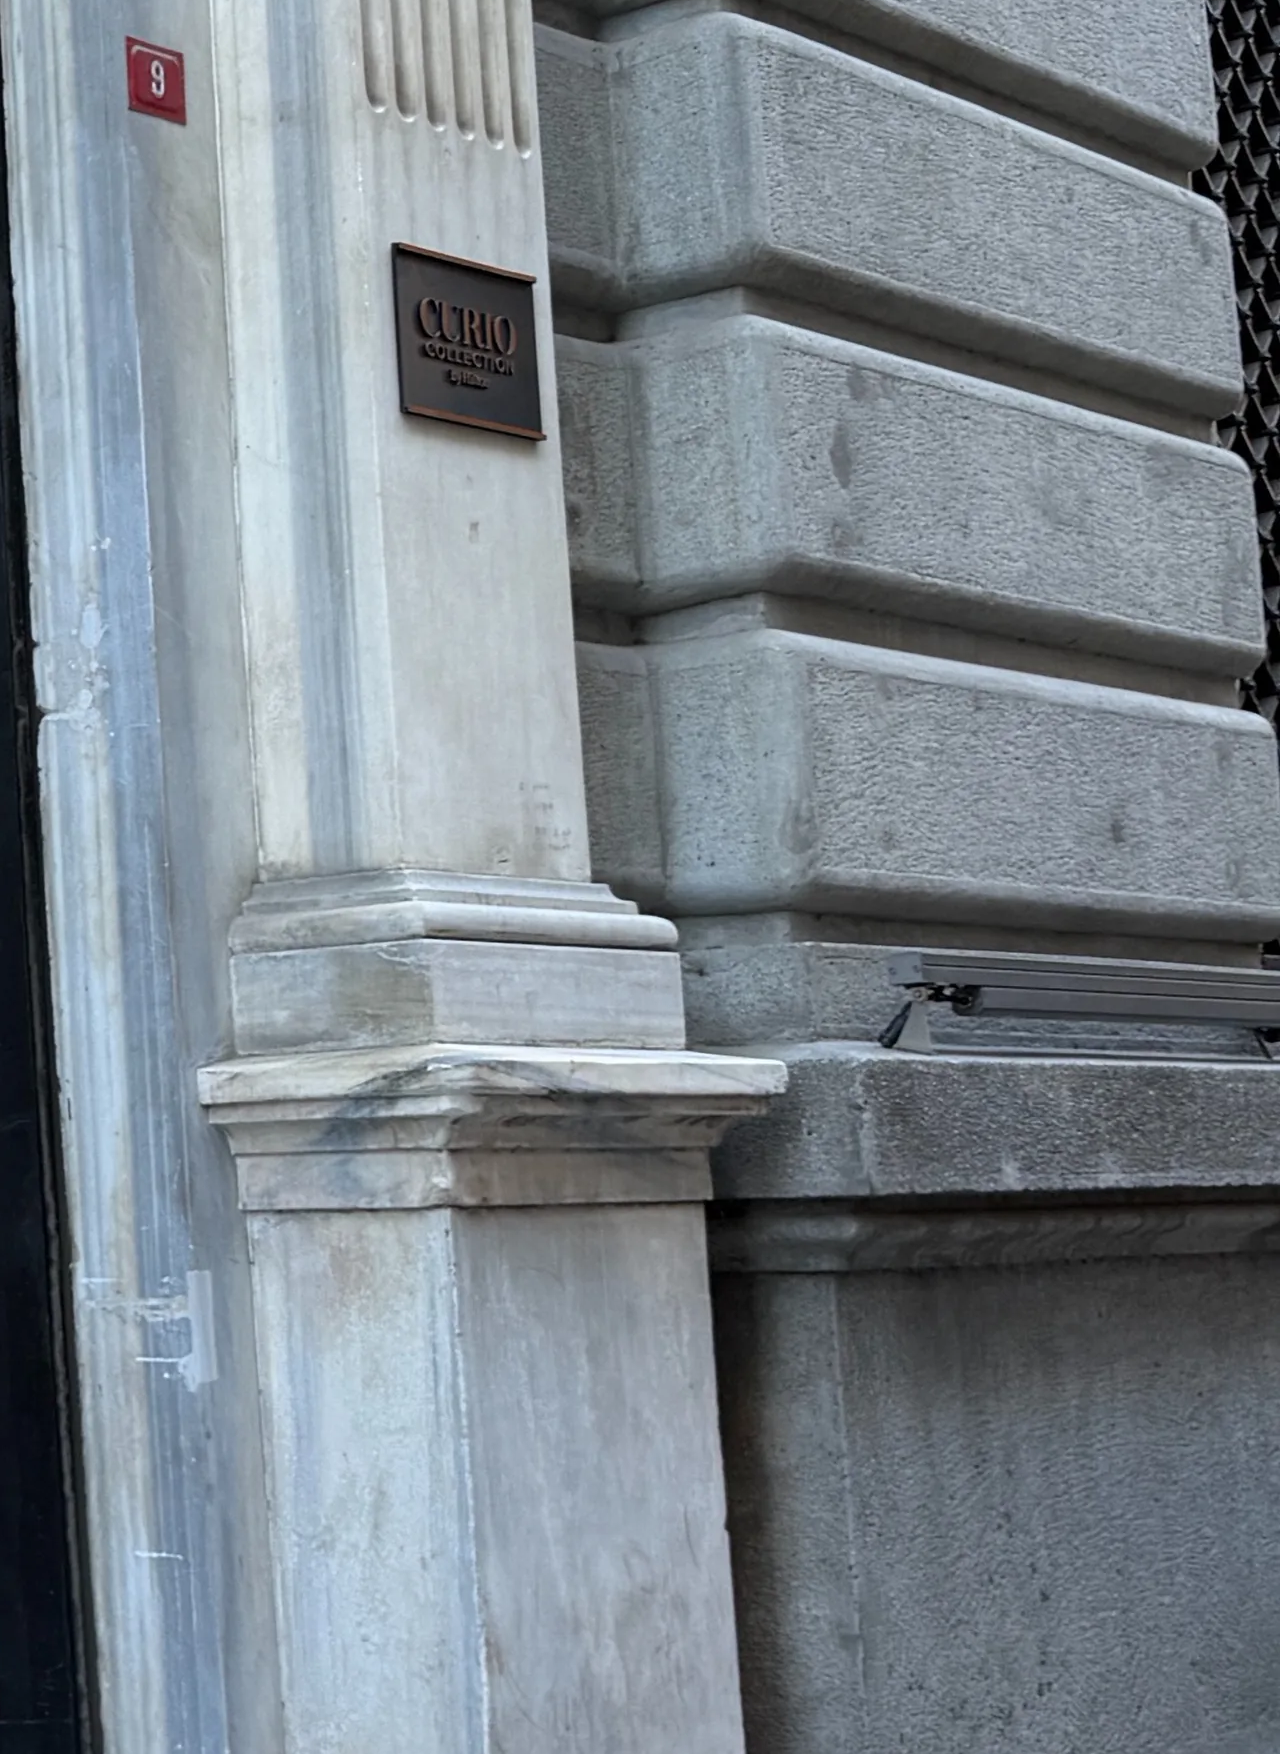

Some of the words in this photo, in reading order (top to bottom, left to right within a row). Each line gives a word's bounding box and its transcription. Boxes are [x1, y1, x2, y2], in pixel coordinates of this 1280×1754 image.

[151, 60, 165, 98] 9
[419, 297, 517, 355] CURIO
[424, 341, 514, 375] COLLECTION
